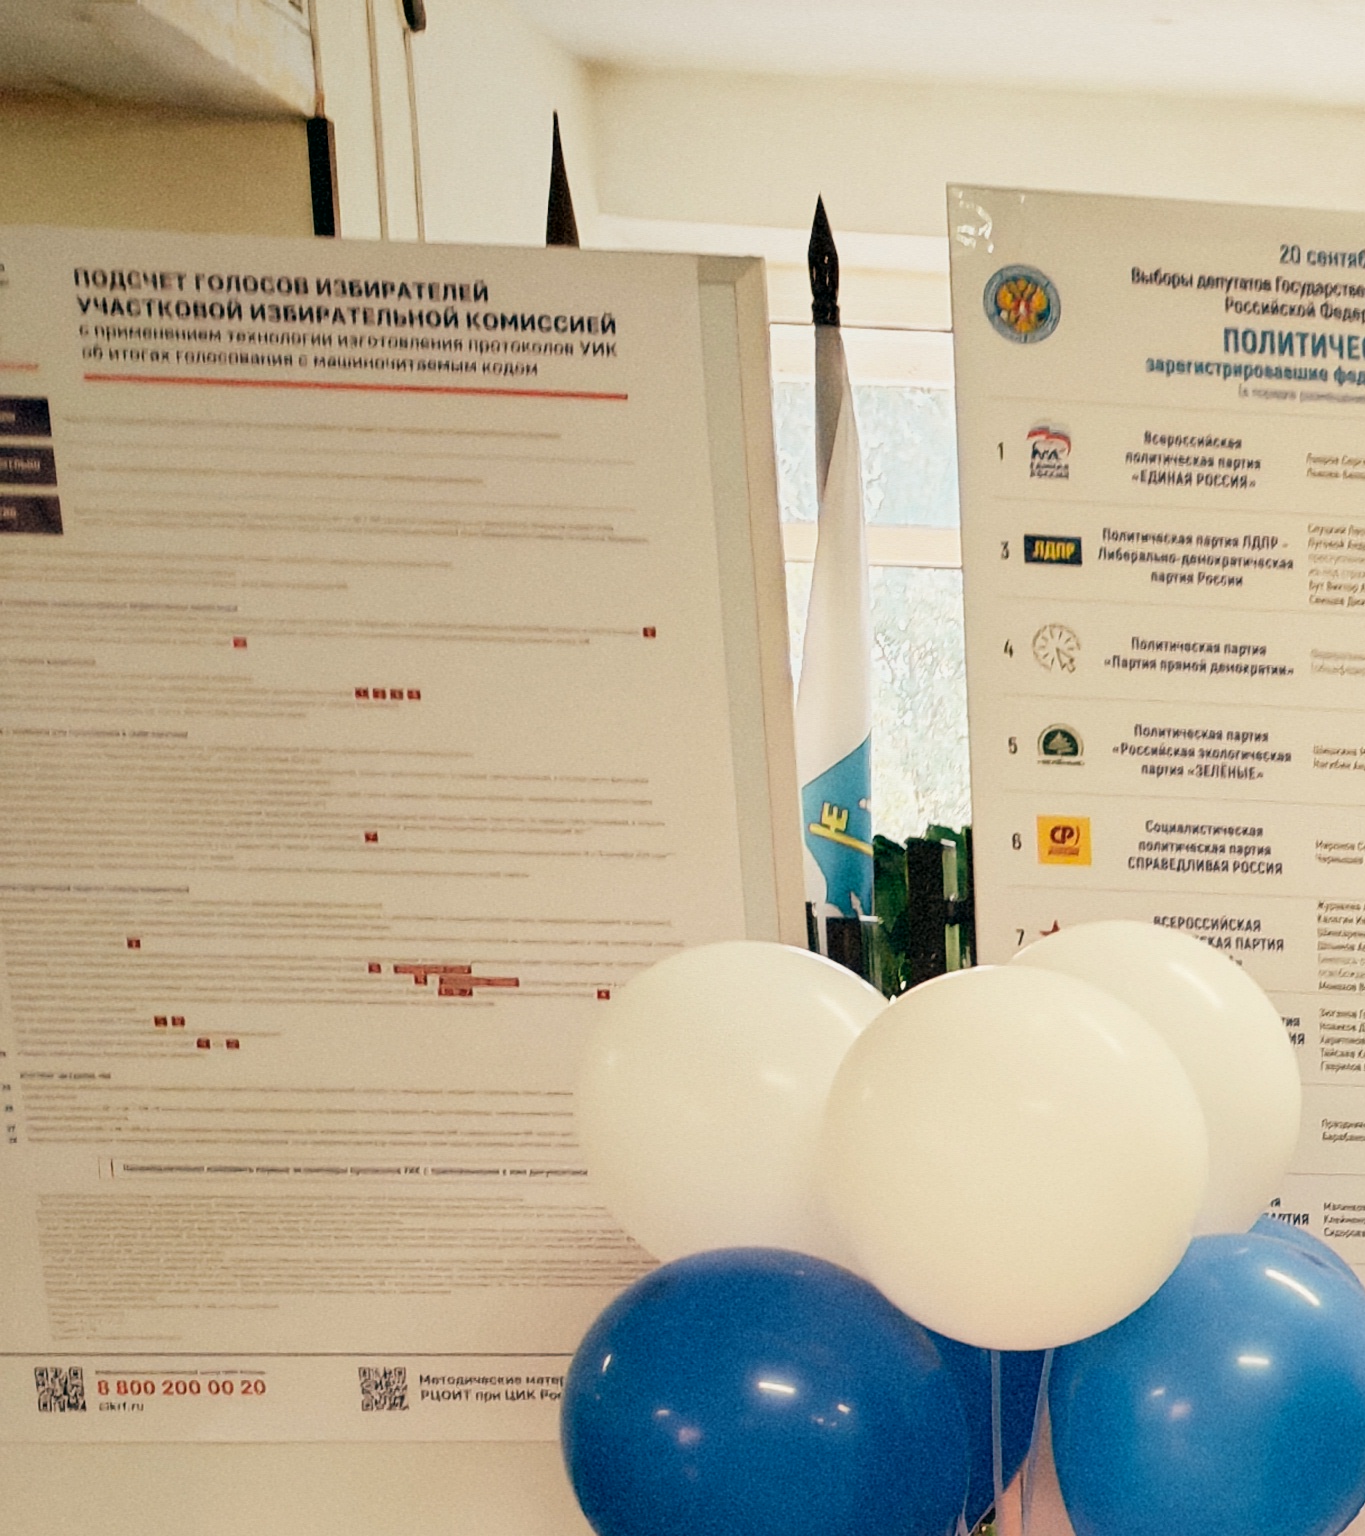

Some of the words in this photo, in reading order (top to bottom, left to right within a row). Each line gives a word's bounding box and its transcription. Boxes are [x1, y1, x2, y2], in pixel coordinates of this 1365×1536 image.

[1280, 244, 1301, 265] 20
[74, 269, 184, 291] ПОДСЧЕТ
[195, 274, 308, 295] ГОЛОСОВ
[316, 279, 488, 302] ИЗБИРАТЕЛЕЙ
[1131, 266, 1193, 289] Выборы
[1197, 275, 1272, 293] депутатов
[78, 297, 242, 320] УЧАСТКОВОЙ
[250, 304, 459, 328] ИЗБИРАТЕЛЬНОЙ
[466, 312, 616, 334] КОМИССИЕЙ
[1224, 296, 1316, 317] Российской
[79, 325, 88, 336] с
[94, 325, 221, 341] применением
[228, 331, 332, 347] технологии
[337, 335, 463, 351] изготовления
[468, 339, 574, 355] протоколов
[580, 341, 616, 358] УИК
[1146, 359, 1328, 382] зарегистрировавшие
[1144, 431, 1242, 450] Всероссийская
[997, 442, 1005, 460] 1
[1125, 451, 1214, 467] политическая
[1218, 458, 1261, 471] партия
[1133, 469, 1193, 486] «ЕДИНАЯ
[1196, 473, 1255, 488] РОССИЯ»
[1102, 527, 1193, 548] Политическая
[1196, 535, 1239, 550] партия
[1243, 535, 1278, 551] ЛДПР
[1000, 540, 1010, 561] 3
[1033, 540, 1076, 560] ЛДПР
[1098, 547, 1294, 569] Либерально-демократическая
[1151, 571, 1194, 585] партия
[1197, 572, 1243, 587] России
[1003, 639, 1014, 658] 4
[1131, 636, 1220, 653] Политическая
[1224, 644, 1267, 657] партия
[1105, 654, 1157, 671] «Партия
[1160, 659, 1207, 673] прямой
[1210, 662, 1294, 676] демократии»
[1134, 724, 1223, 740] Политическая
[1226, 731, 1269, 744] партия
[1008, 736, 1018, 754] 5
[1113, 742, 1195, 758] «Российская
[1199, 748, 1292, 762] экологическая
[1141, 764, 1184, 778] партия
[1188, 763, 1263, 780] «ЗЕЛЁНЫЕ»
[1145, 819, 1263, 837] Социалистическая
[1138, 841, 1226, 859] политическая
[1229, 845, 1271, 857] партия
[1128, 856, 1229, 872] СПРАВЕДЛИВАЯ
[1232, 860, 1283, 875] РОССИЯ
[1016, 929, 1025, 945] 7
[1235, 936, 1284, 951] ПАРТИЯ
[97, 1379, 109, 1395] 8
[116, 1379, 155, 1395] 800
[162, 1379, 201, 1395] 200
[208, 1379, 234, 1395] 00
[241, 1379, 266, 1395] 20
[420, 1389, 471, 1402] РЦОИТ
[475, 1390, 501, 1403] при
[505, 1389, 536, 1402] ЦИК
